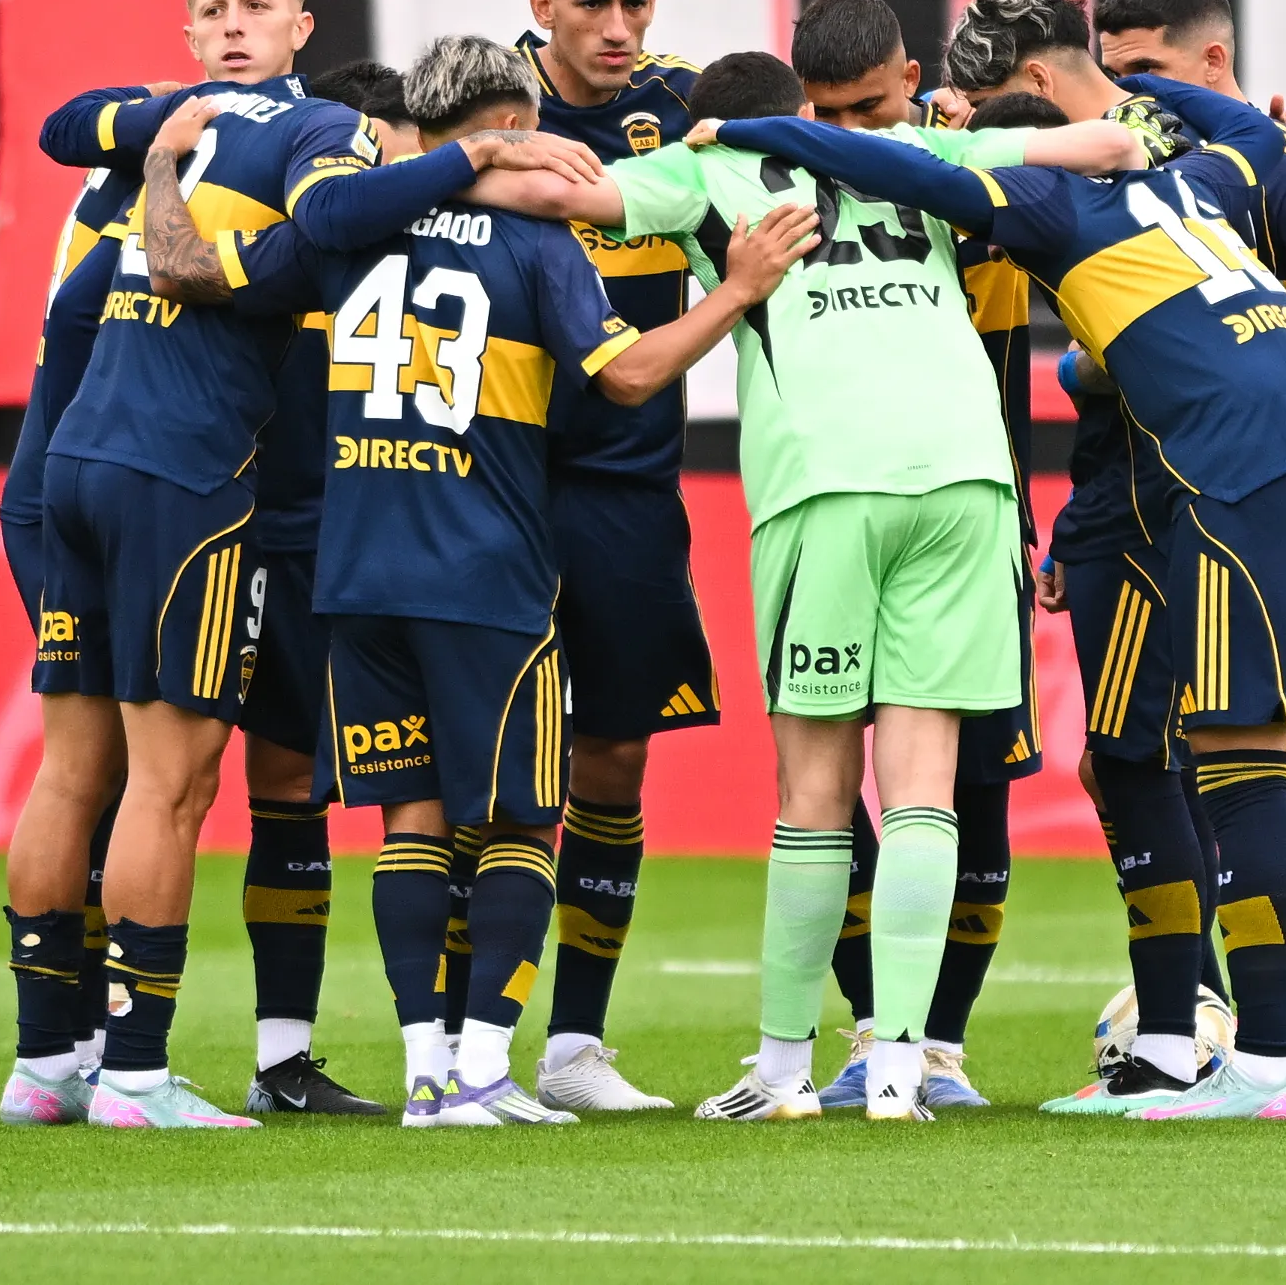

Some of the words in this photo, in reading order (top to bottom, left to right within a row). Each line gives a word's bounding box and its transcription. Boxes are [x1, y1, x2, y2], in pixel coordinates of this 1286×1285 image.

[403, 207, 493, 247] GADO
[806, 282, 941, 320] DIRECTV
[331, 254, 491, 436] 43
[334, 435, 473, 478] DIRECTV
[246, 567, 268, 640] 9
[789, 642, 862, 680] pax
[787, 680, 862, 695] assistance
[342, 714, 429, 763] pax
[349, 753, 432, 775] assistance
